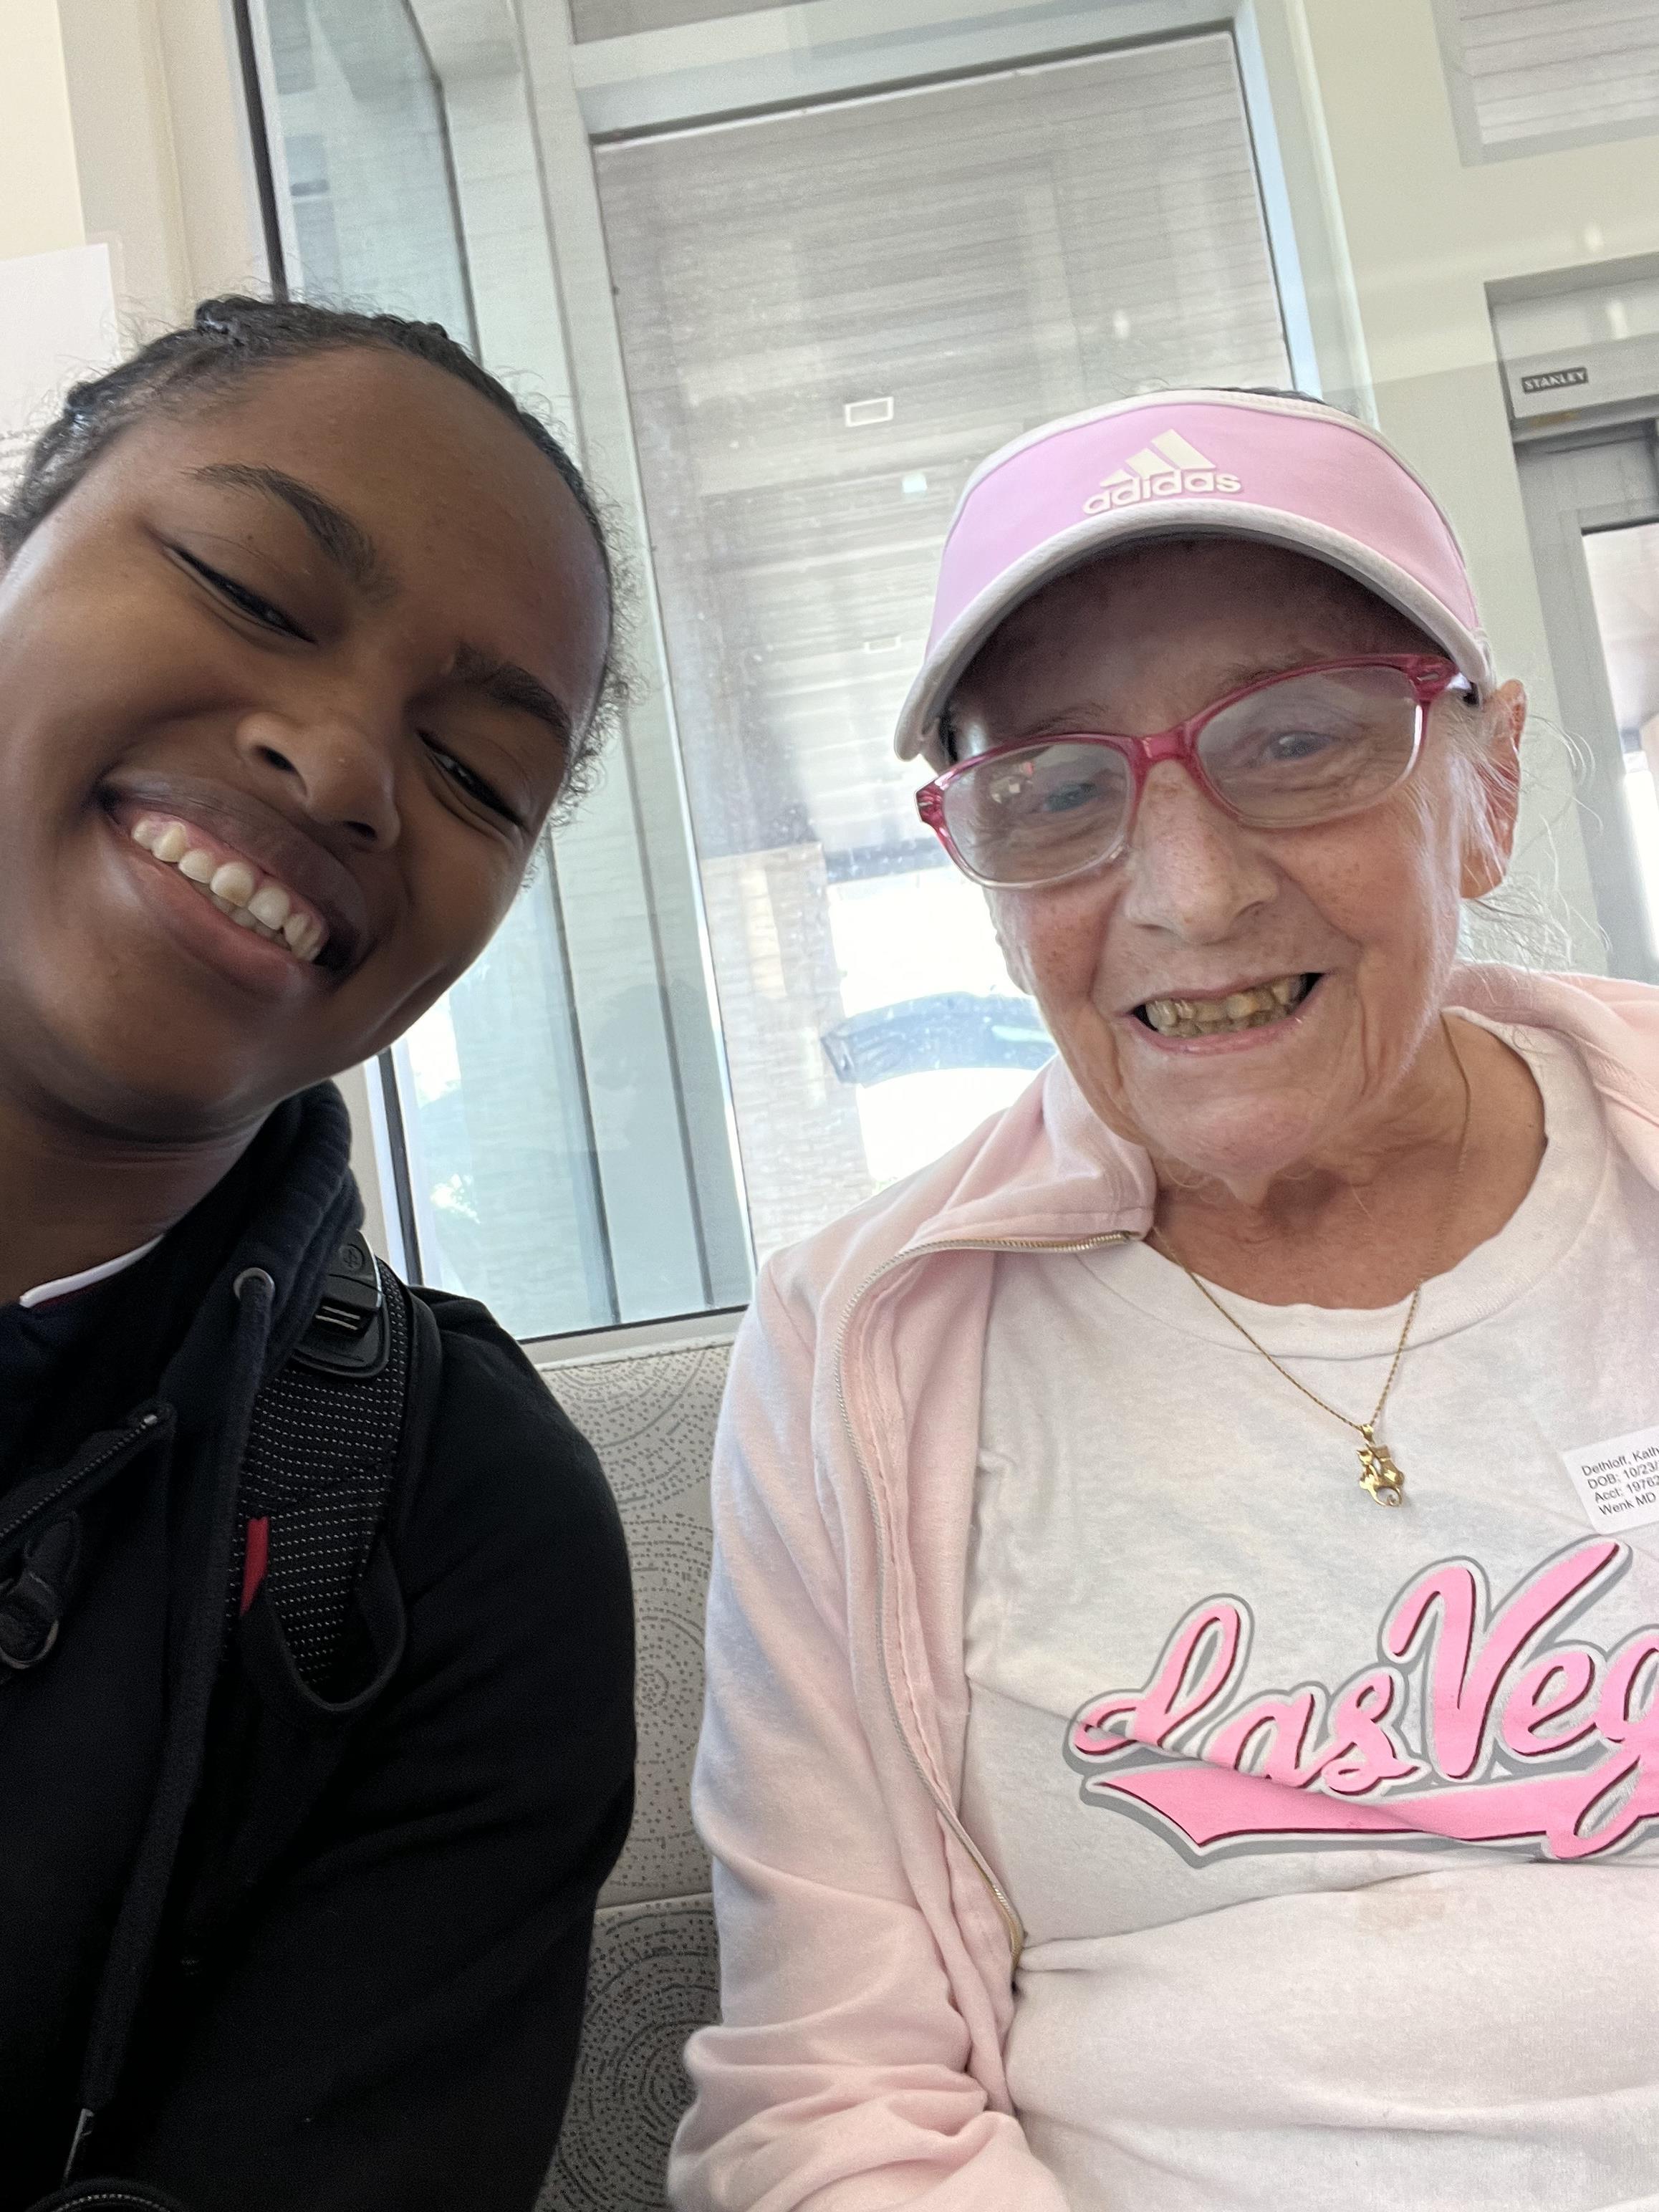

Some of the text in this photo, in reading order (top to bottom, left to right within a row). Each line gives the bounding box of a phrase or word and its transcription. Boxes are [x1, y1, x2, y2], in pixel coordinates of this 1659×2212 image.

[1524, 370, 1585, 390] STANLEY
[1082, 468, 1242, 515] adidas
[1587, 1473, 1622, 1490] DOB:
[1595, 1487, 1623, 1504] Acct:
[1598, 1491, 1657, 1516] Wenk MD
[1067, 1595, 1424, 1798] Las
